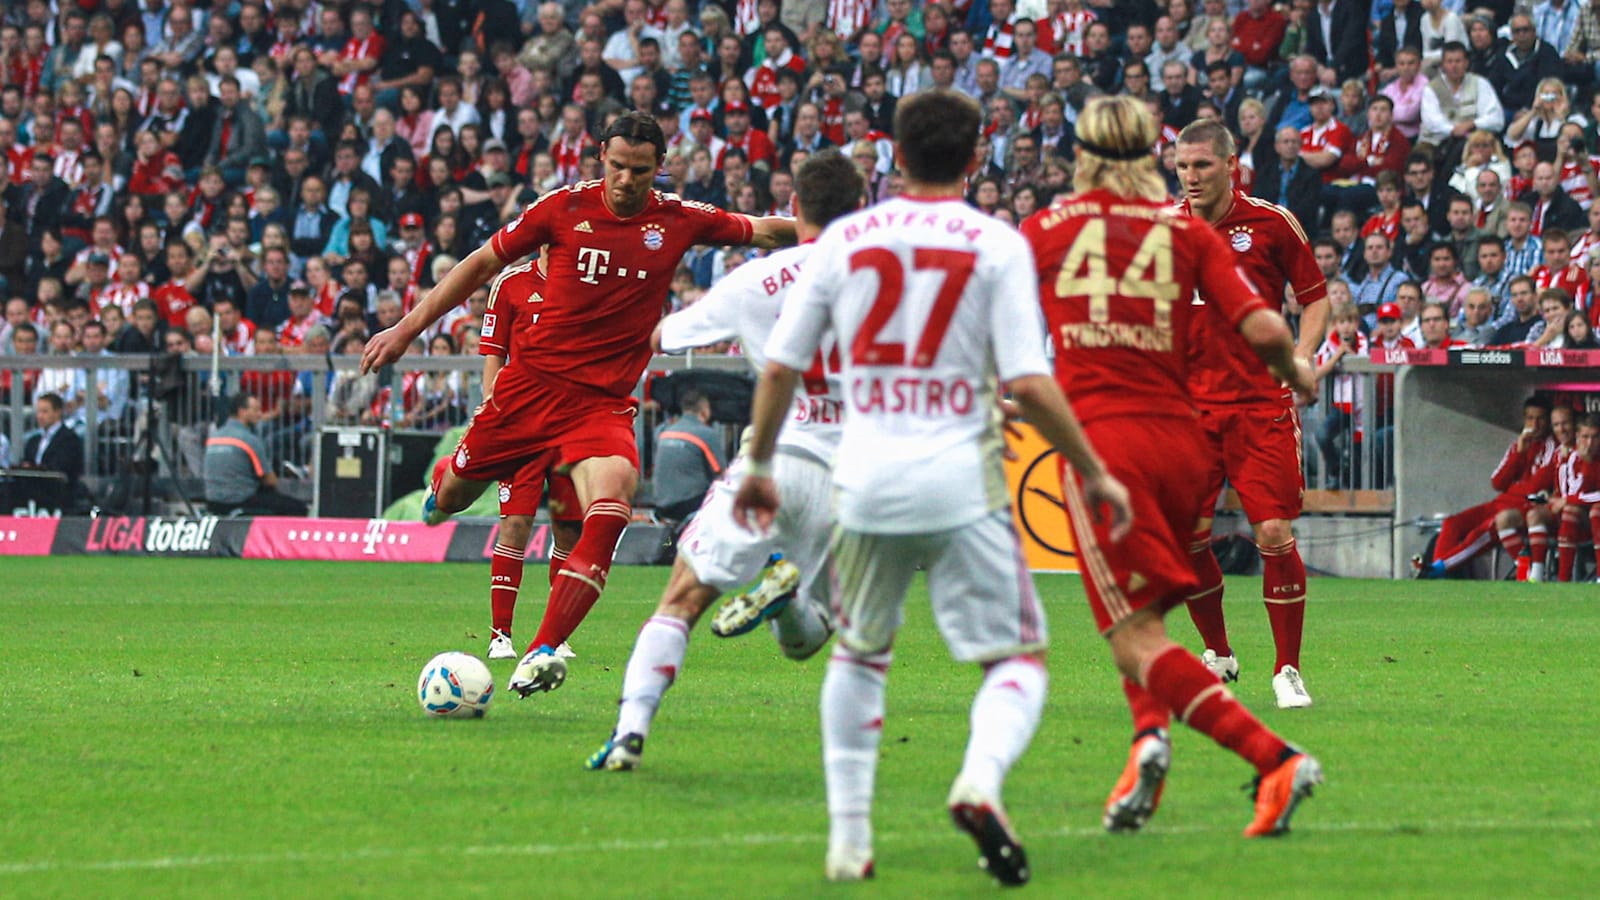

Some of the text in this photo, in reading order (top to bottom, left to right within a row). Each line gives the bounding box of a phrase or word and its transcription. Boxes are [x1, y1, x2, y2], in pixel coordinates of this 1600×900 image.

[843, 211, 983, 242] BAYER 04
[1055, 218, 1181, 328] 44
[849, 246, 978, 369] 27
[1385, 350, 1408, 363] LIGA
[1480, 351, 1512, 364] adidas
[1540, 352, 1563, 365] LIGA
[852, 377, 975, 416] CASTRO
[85, 516, 219, 551] LIGA total!
